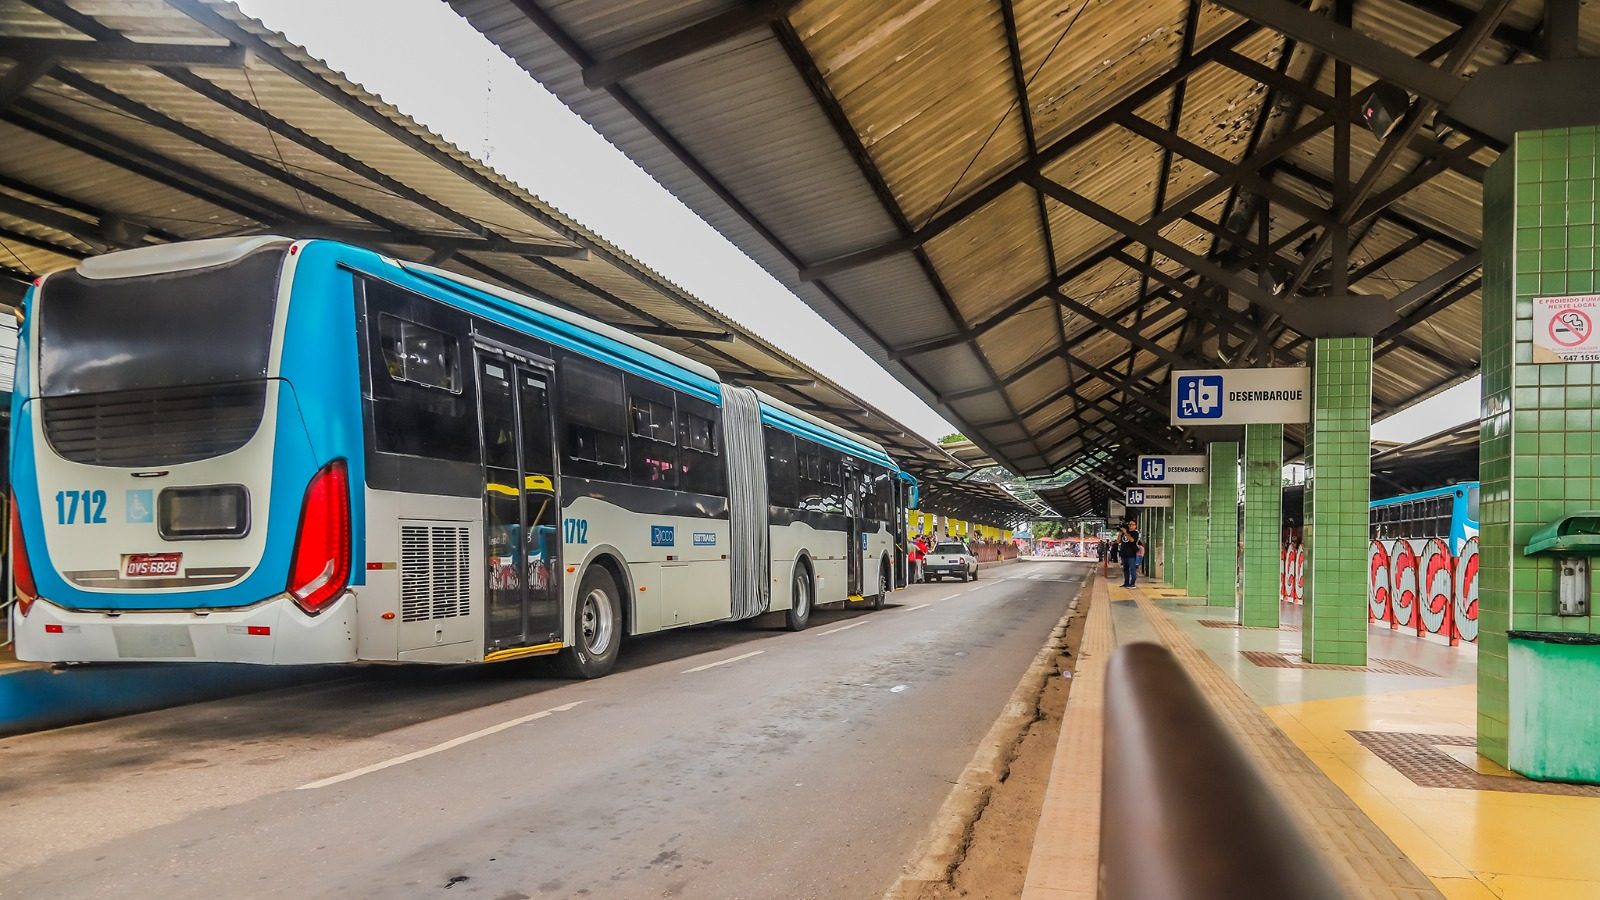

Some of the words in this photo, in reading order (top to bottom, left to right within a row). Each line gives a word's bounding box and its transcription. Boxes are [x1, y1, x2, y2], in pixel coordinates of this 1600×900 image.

[1229, 390, 1303, 402] DESEMBARQUE
[55, 489, 108, 525] 1712
[564, 519, 588, 544] 1712
